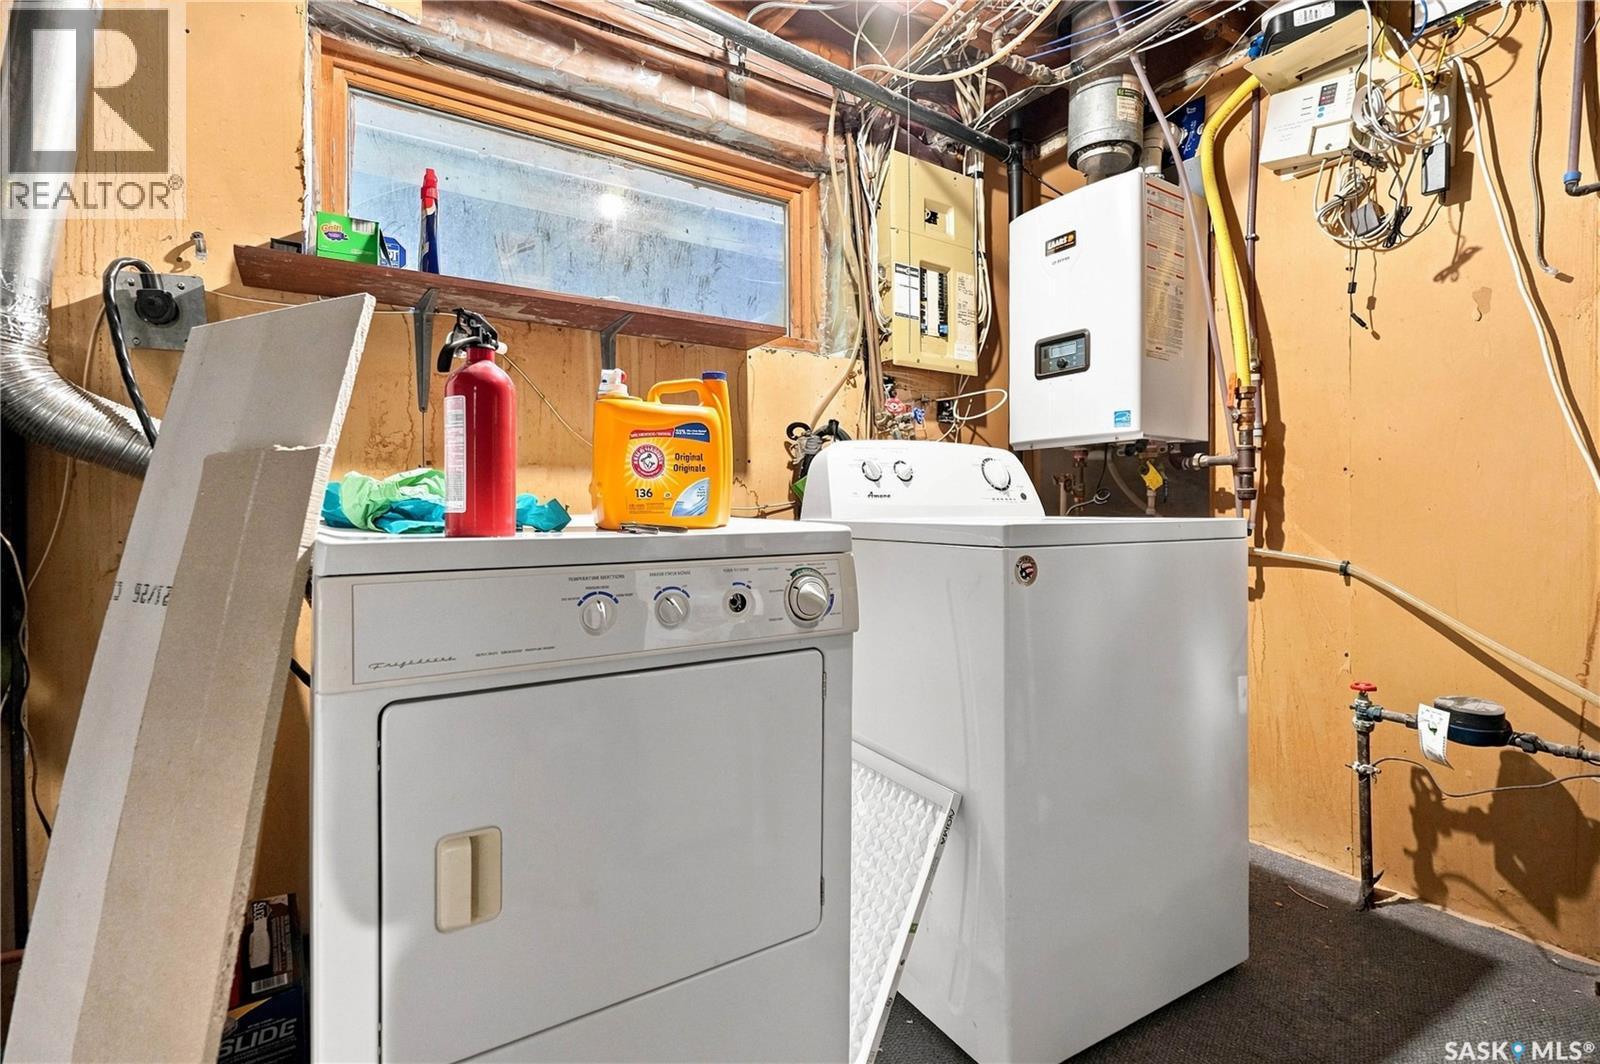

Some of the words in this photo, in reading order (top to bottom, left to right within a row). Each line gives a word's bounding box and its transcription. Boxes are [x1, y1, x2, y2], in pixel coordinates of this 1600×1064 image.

[674, 452, 704, 463] Original
[673, 463, 706, 474] Originale
[634, 488, 653, 498] 136
